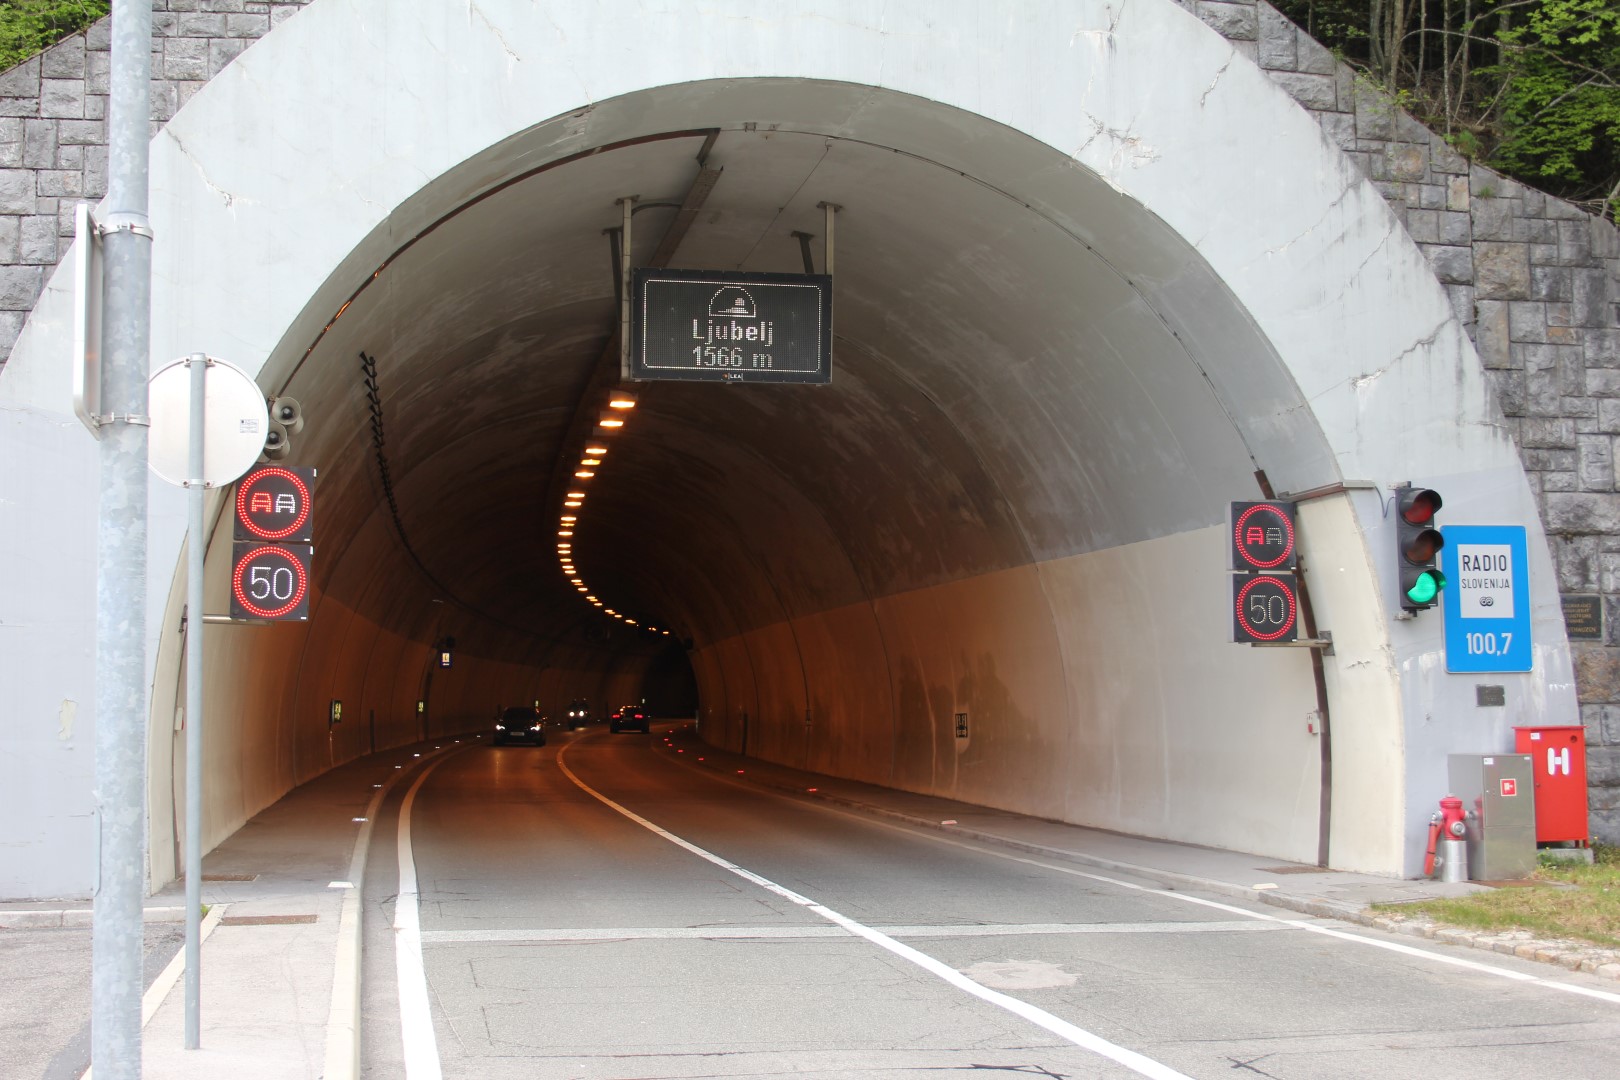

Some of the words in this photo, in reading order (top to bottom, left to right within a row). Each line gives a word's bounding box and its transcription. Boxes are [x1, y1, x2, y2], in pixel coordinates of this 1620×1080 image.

[692, 318, 773, 347] Ljubelj
[692, 345, 743, 367] 1566
[752, 353, 773, 368] m
[1462, 554, 1507, 572] RADIO
[250, 566, 293, 600] 50
[1461, 578, 1510, 589] SLOVENIJA
[1250, 594, 1284, 624] 50
[1466, 632, 1513, 656] 100,7
[1547, 747, 1569, 775] H
